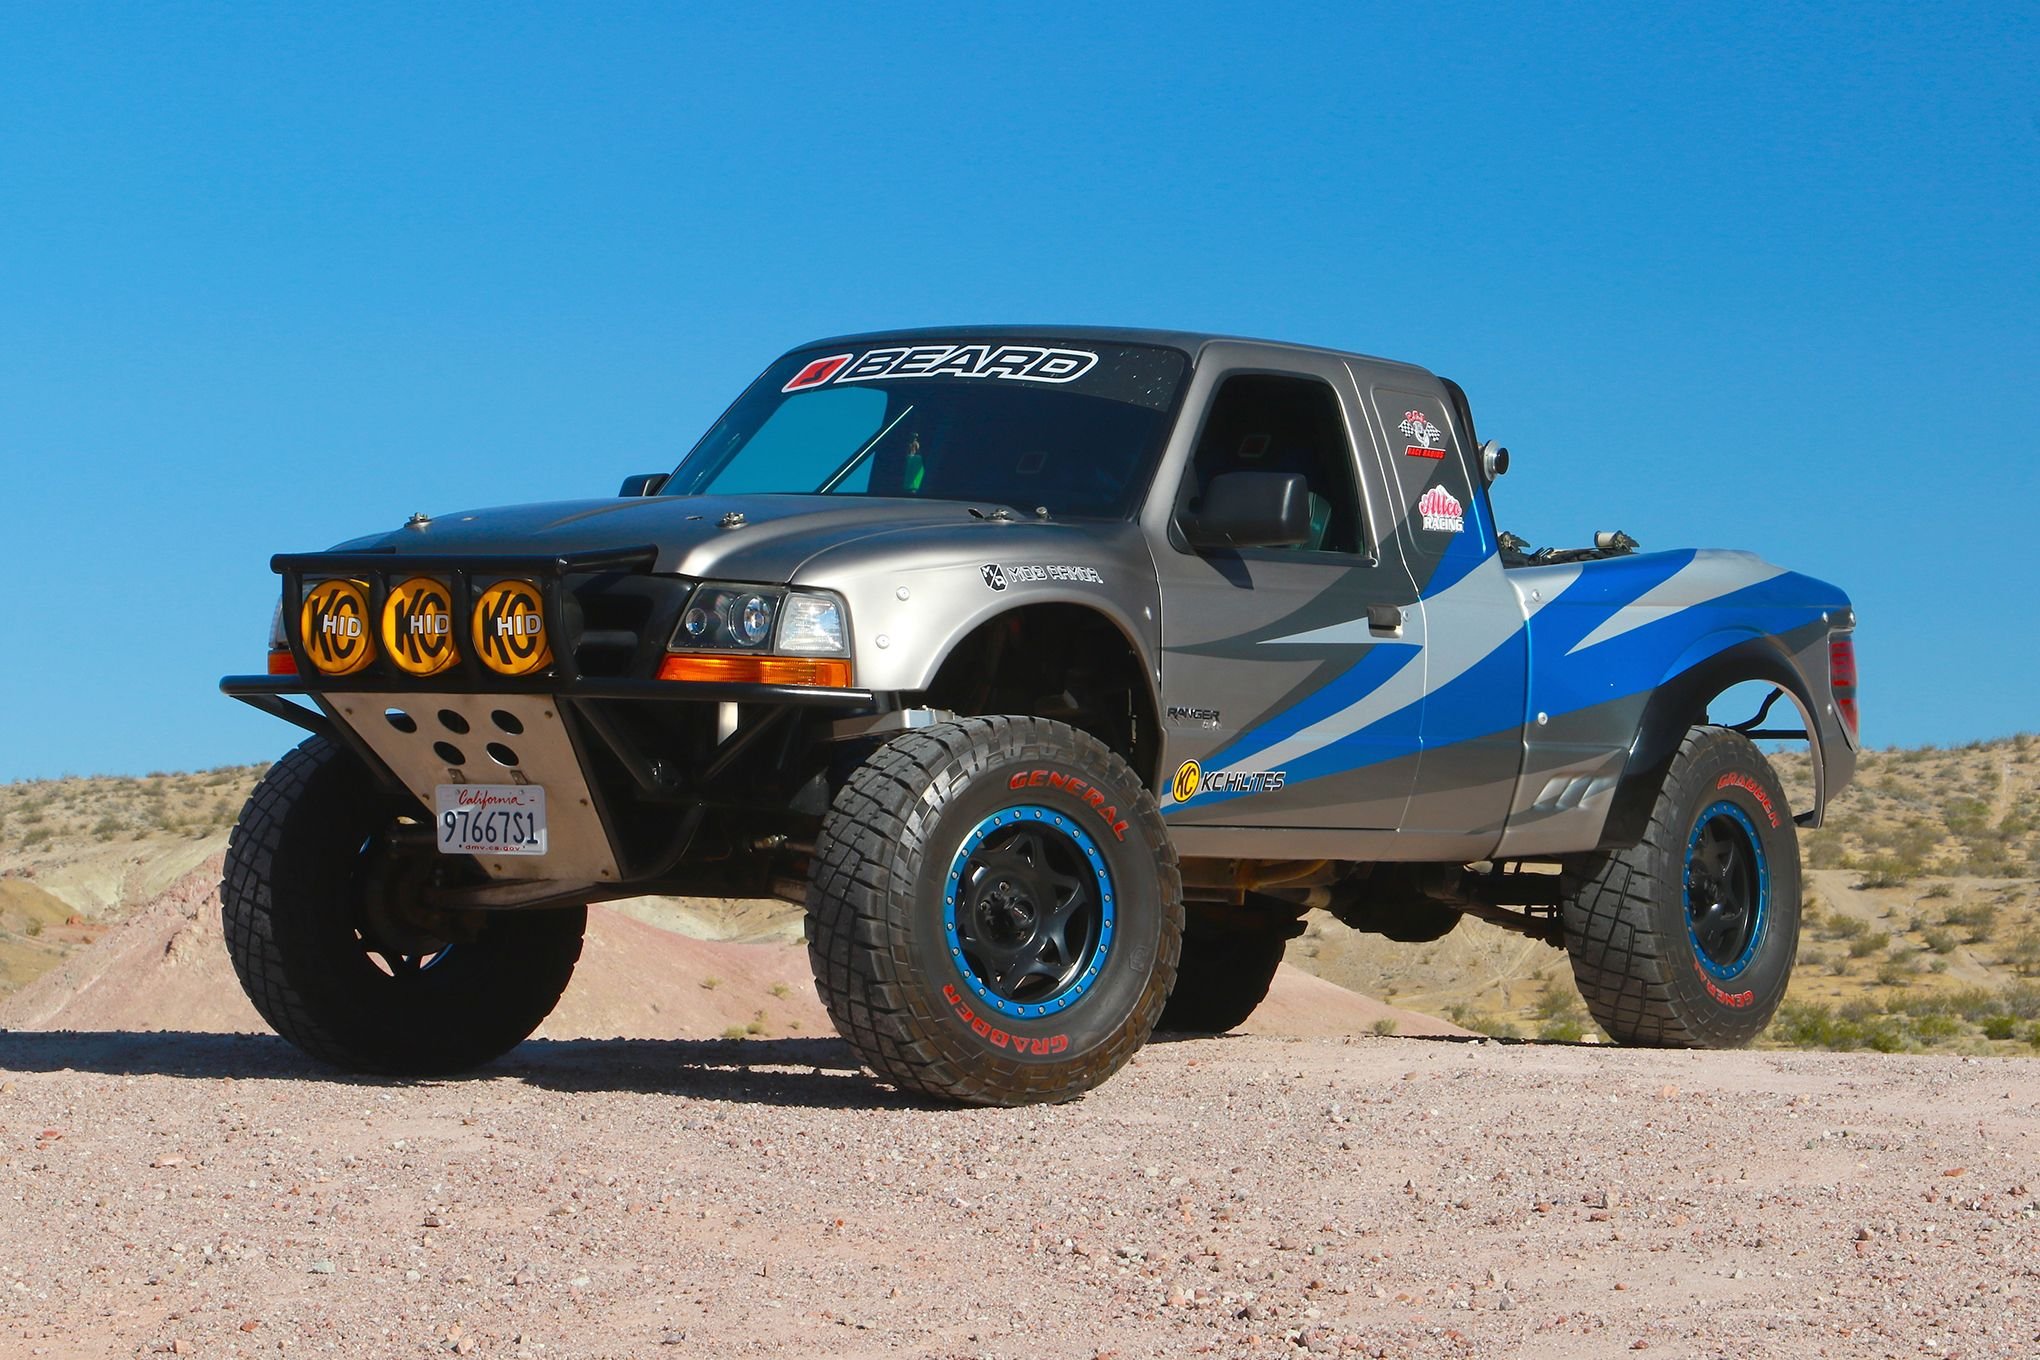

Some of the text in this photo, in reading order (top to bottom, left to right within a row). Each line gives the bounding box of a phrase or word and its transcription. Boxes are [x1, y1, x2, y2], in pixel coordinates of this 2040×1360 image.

[834, 345, 1099, 383] BEARD
[1423, 516, 1464, 532] RACING
[1006, 565, 1047, 583] MOB
[310, 589, 359, 662] KC
[322, 614, 362, 637] HID
[394, 588, 448, 663] KC
[410, 614, 449, 634] HID
[482, 590, 537, 664] KC
[497, 614, 542, 636] HID
[1167, 707, 1220, 721] RANGER
[1175, 765, 1197, 798] KC
[458, 789, 524, 809] California
[1009, 770, 1130, 842] GENERAL
[1717, 772, 1780, 829] GRABBER
[444, 811, 538, 844] 97667S1
[465, 844, 520, 852] dmv.ca.gov
[942, 984, 1069, 1055] GRABBER
